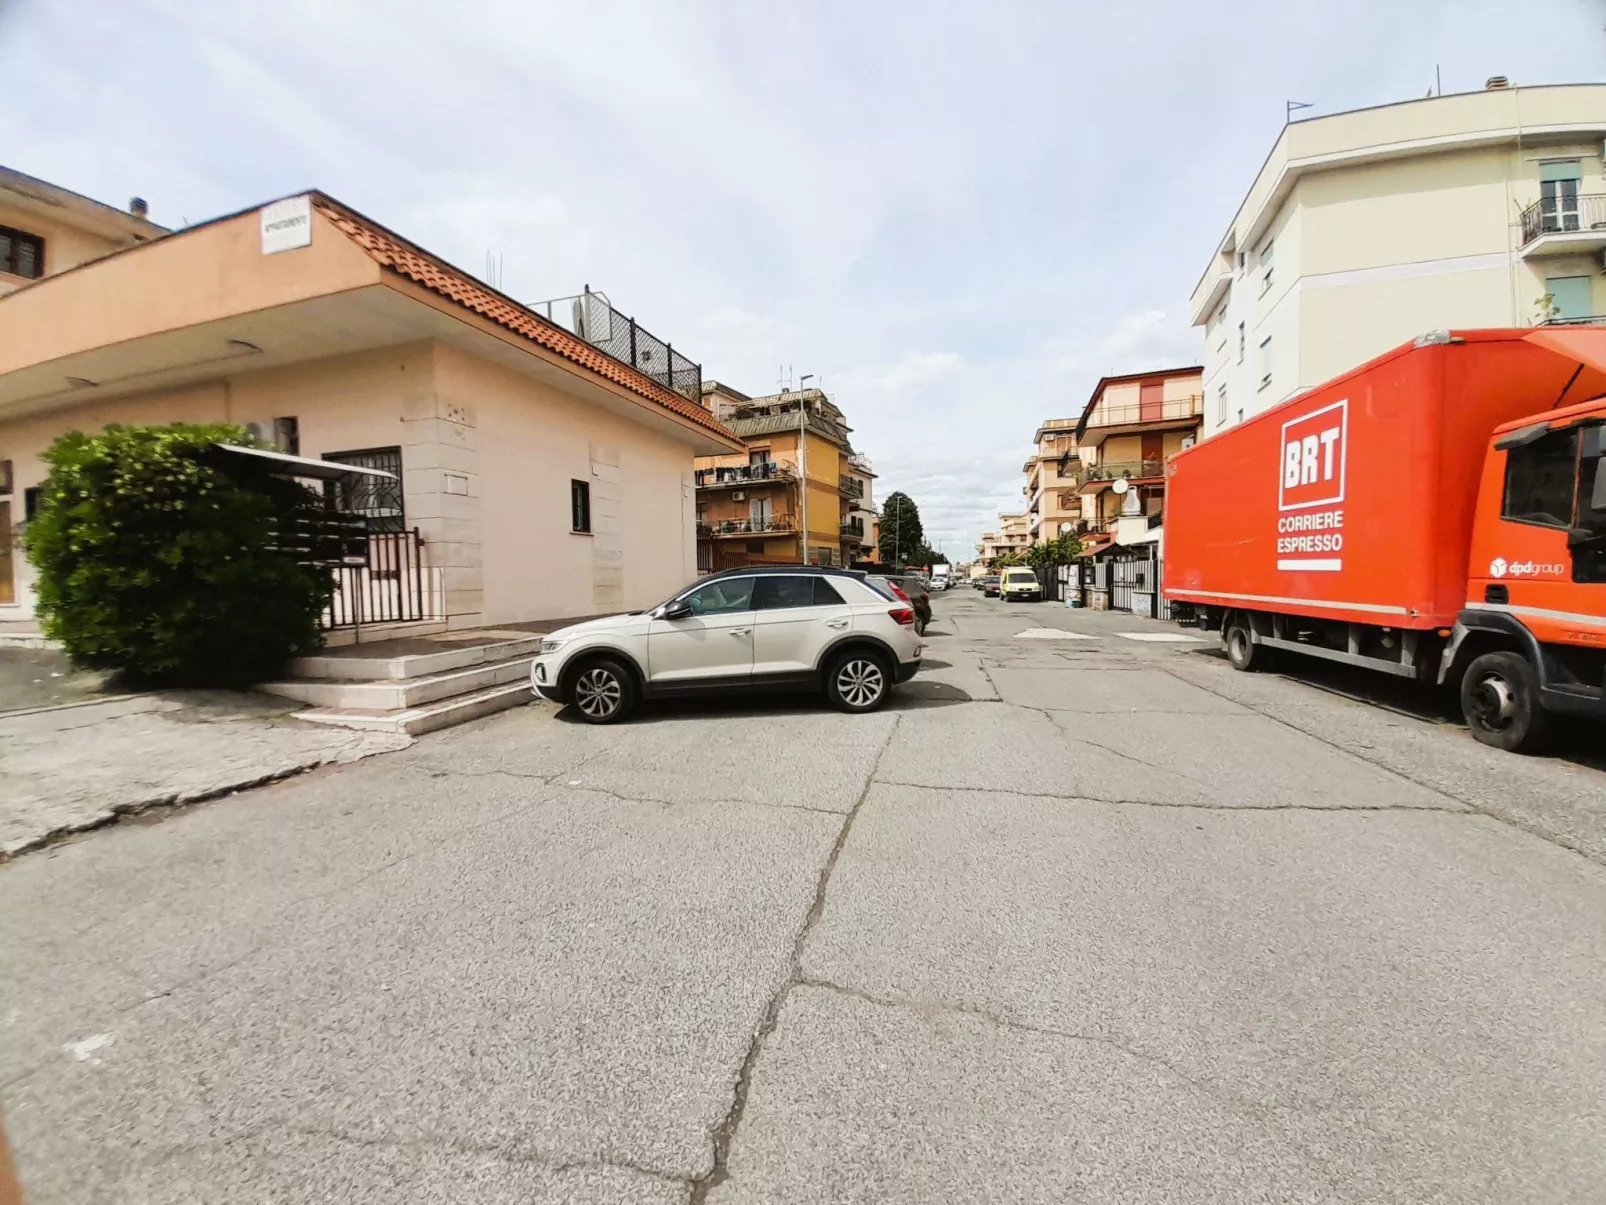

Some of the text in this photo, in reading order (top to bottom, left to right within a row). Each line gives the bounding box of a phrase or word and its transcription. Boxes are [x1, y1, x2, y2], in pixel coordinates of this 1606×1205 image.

[1284, 427, 1340, 489] BRT
[1278, 510, 1344, 533] CORRIERE
[1277, 533, 1342, 553] ESPRESSO
[1508, 561, 1564, 576] dpdgroup
